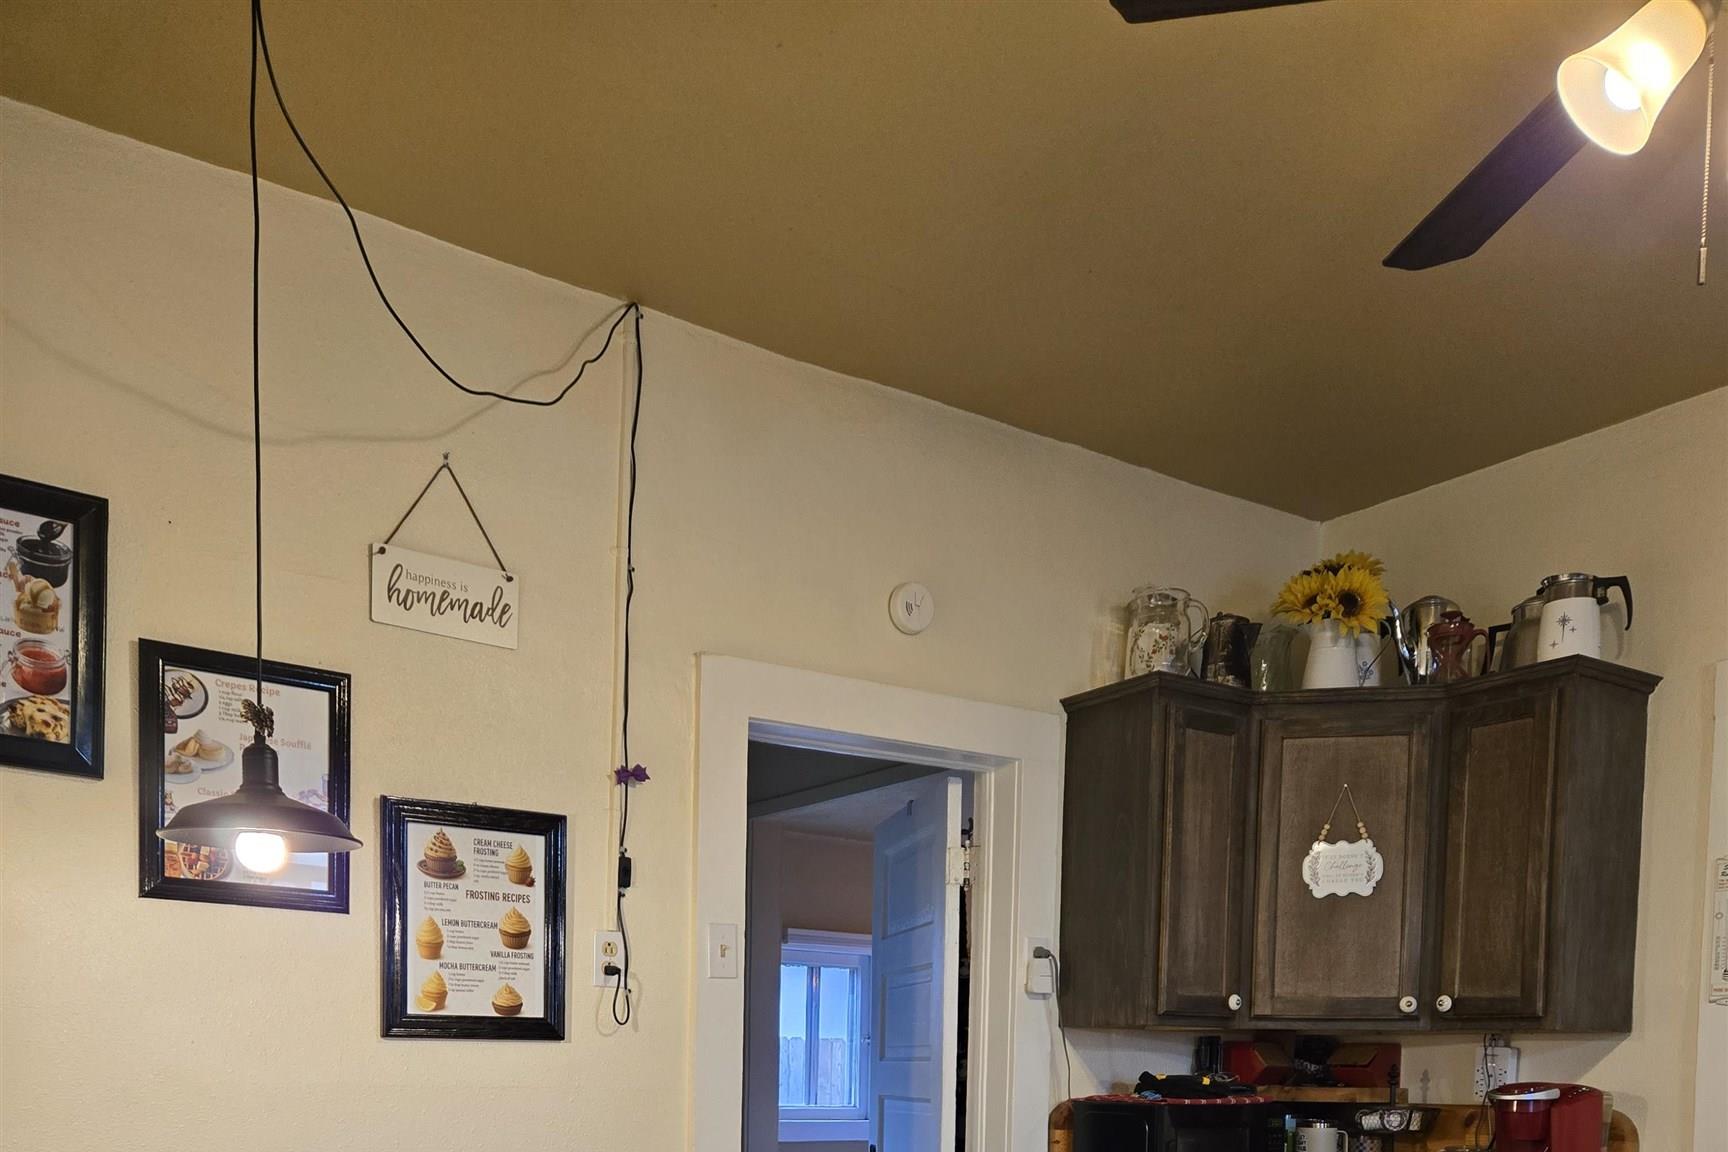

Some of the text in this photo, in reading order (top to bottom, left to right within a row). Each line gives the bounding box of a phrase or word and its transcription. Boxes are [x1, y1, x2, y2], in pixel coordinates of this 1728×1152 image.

[405, 569, 469, 593] happiness is
[387, 563, 513, 628] homemade
[215, 679, 281, 697] Crepes Rcipe
[473, 838, 513, 850] CREAM CHEESE
[473, 847, 500, 857] FROSTING
[423, 880, 460, 890] BUTTER PECAN
[465, 889, 500, 901] FROSTING
[502, 892, 531, 904] RECIPES
[441, 918, 498, 930] LEMON BUTTERCREAM
[490, 950, 534, 960] VANILLA FROSTING
[439, 961, 458, 970] MOCHA
[459, 962, 497, 972] BUTTERCREAM
